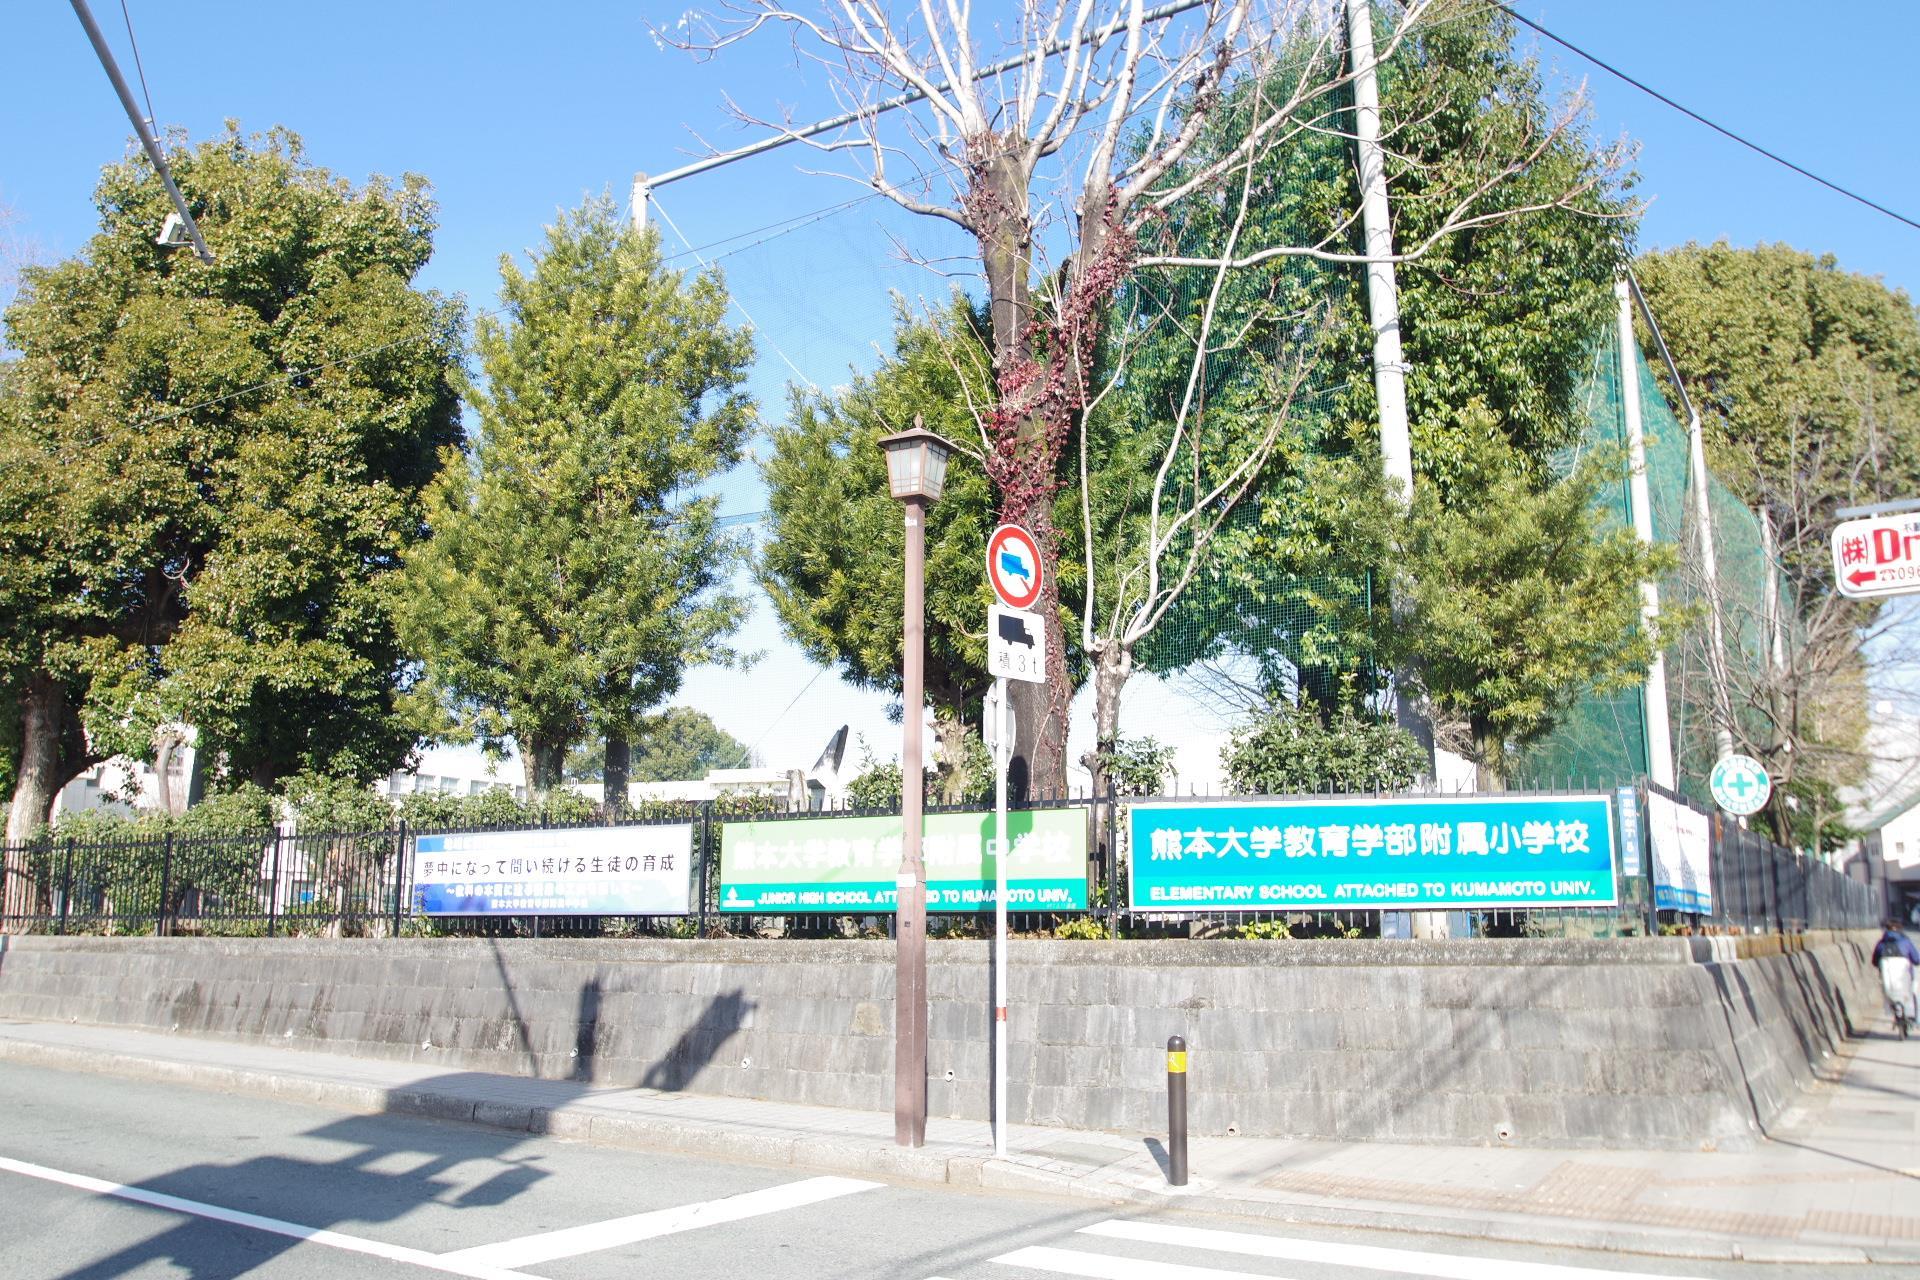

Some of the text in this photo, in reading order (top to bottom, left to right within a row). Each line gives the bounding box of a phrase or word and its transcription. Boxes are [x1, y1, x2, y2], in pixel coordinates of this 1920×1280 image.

[733, 830, 1073, 870] 熊本大学教育学附属中学校
[1150, 819, 1590, 861] 熊本大学教育学部附属小学校
[423, 853, 676, 878] 夢中になって問い続ける生徒の育成
[757, 887, 1073, 905] JUNIOR HIGH SCHOOL ATTED TO KUMAOTO UNIV.
[1150, 880, 1596, 902] ELEMENTARY SCHOOL ATTACHED TO KUMAMOTO UNIV.
